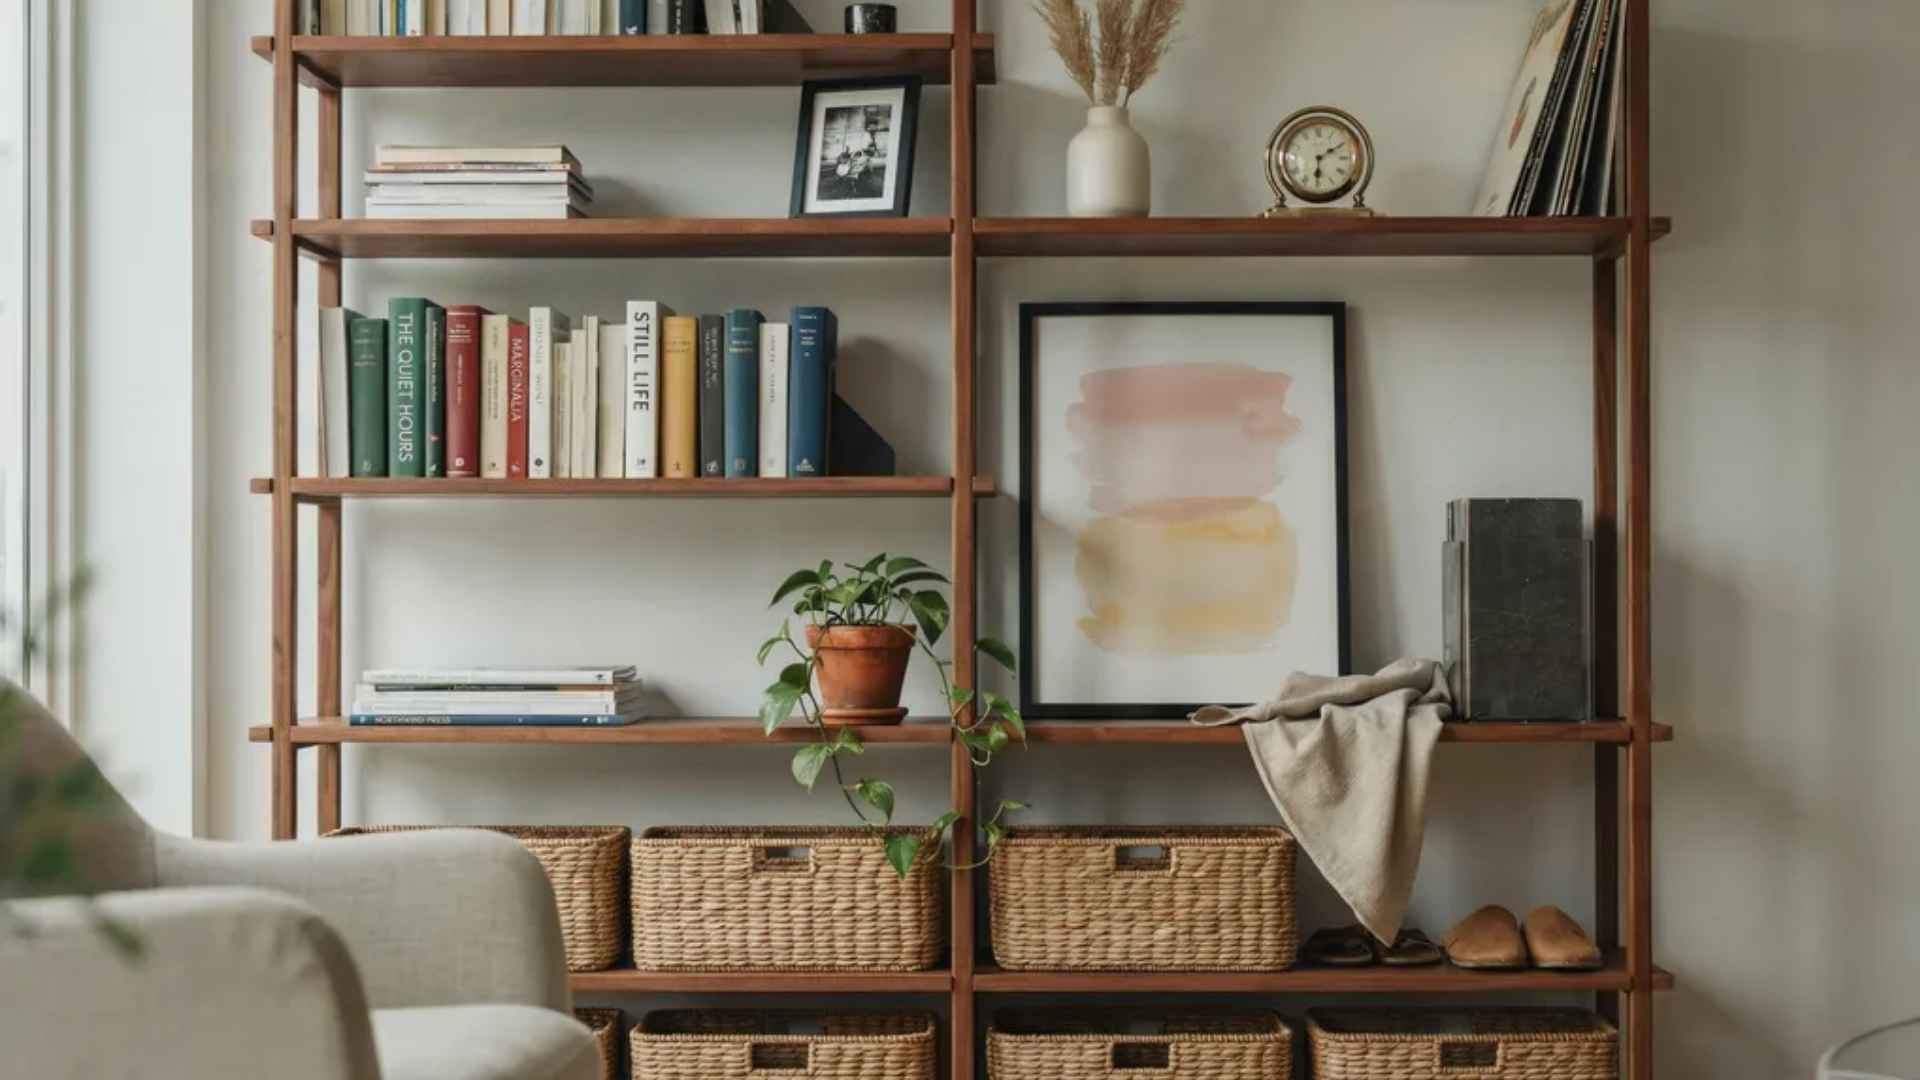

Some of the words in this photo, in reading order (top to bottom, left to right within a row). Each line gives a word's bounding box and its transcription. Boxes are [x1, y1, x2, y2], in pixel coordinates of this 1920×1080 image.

[398, 312, 414, 345] THE
[633, 312, 649, 364] STILL
[397, 350, 414, 399] QUIET
[510, 338, 522, 422] MARGINALIA
[633, 372, 649, 411] LIFE
[398, 404, 414, 463] HOURS
